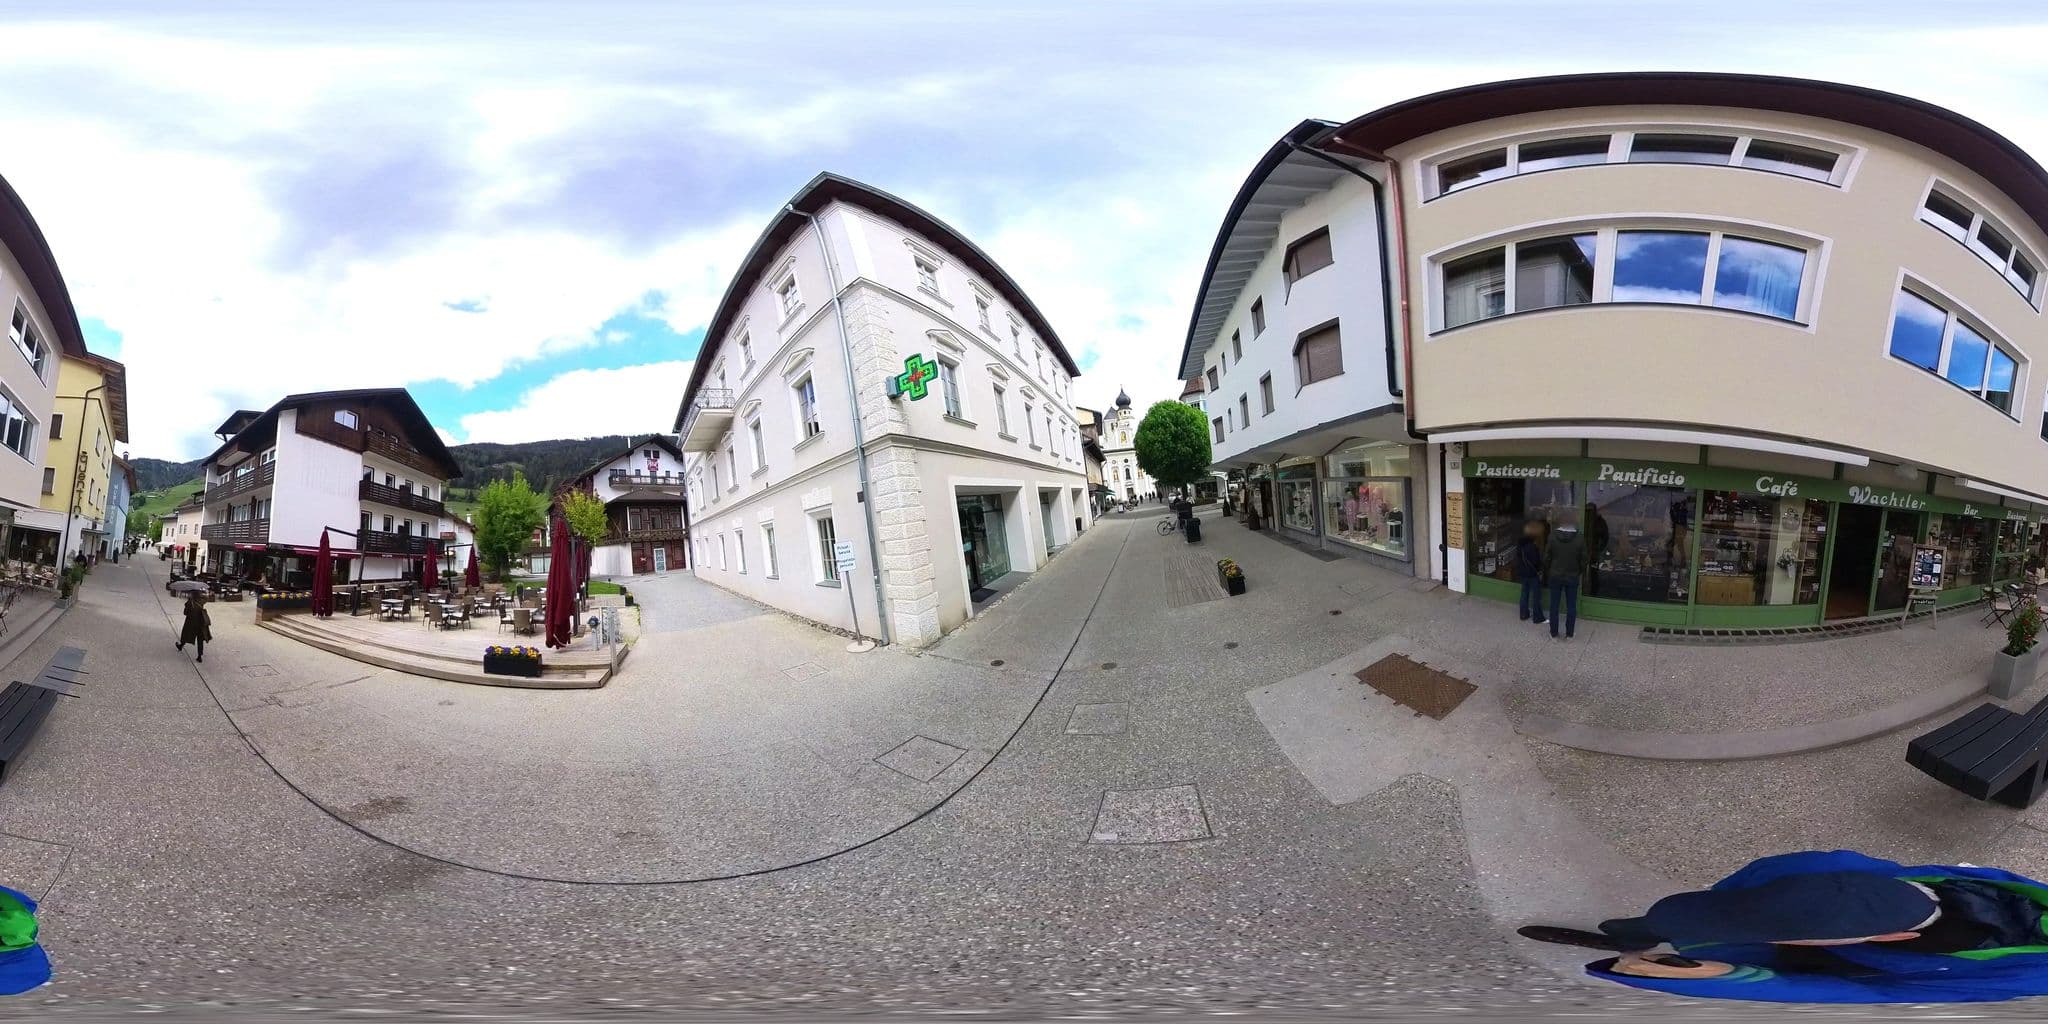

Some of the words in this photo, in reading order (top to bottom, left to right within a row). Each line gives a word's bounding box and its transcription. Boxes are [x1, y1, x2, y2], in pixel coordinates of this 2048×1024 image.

[1476, 461, 1560, 478] Pasticceria
[1598, 464, 1685, 486] Panificio
[1755, 475, 1799, 497] Café
[1848, 485, 1927, 511] Wachtler
[1963, 504, 1979, 516] Bar
